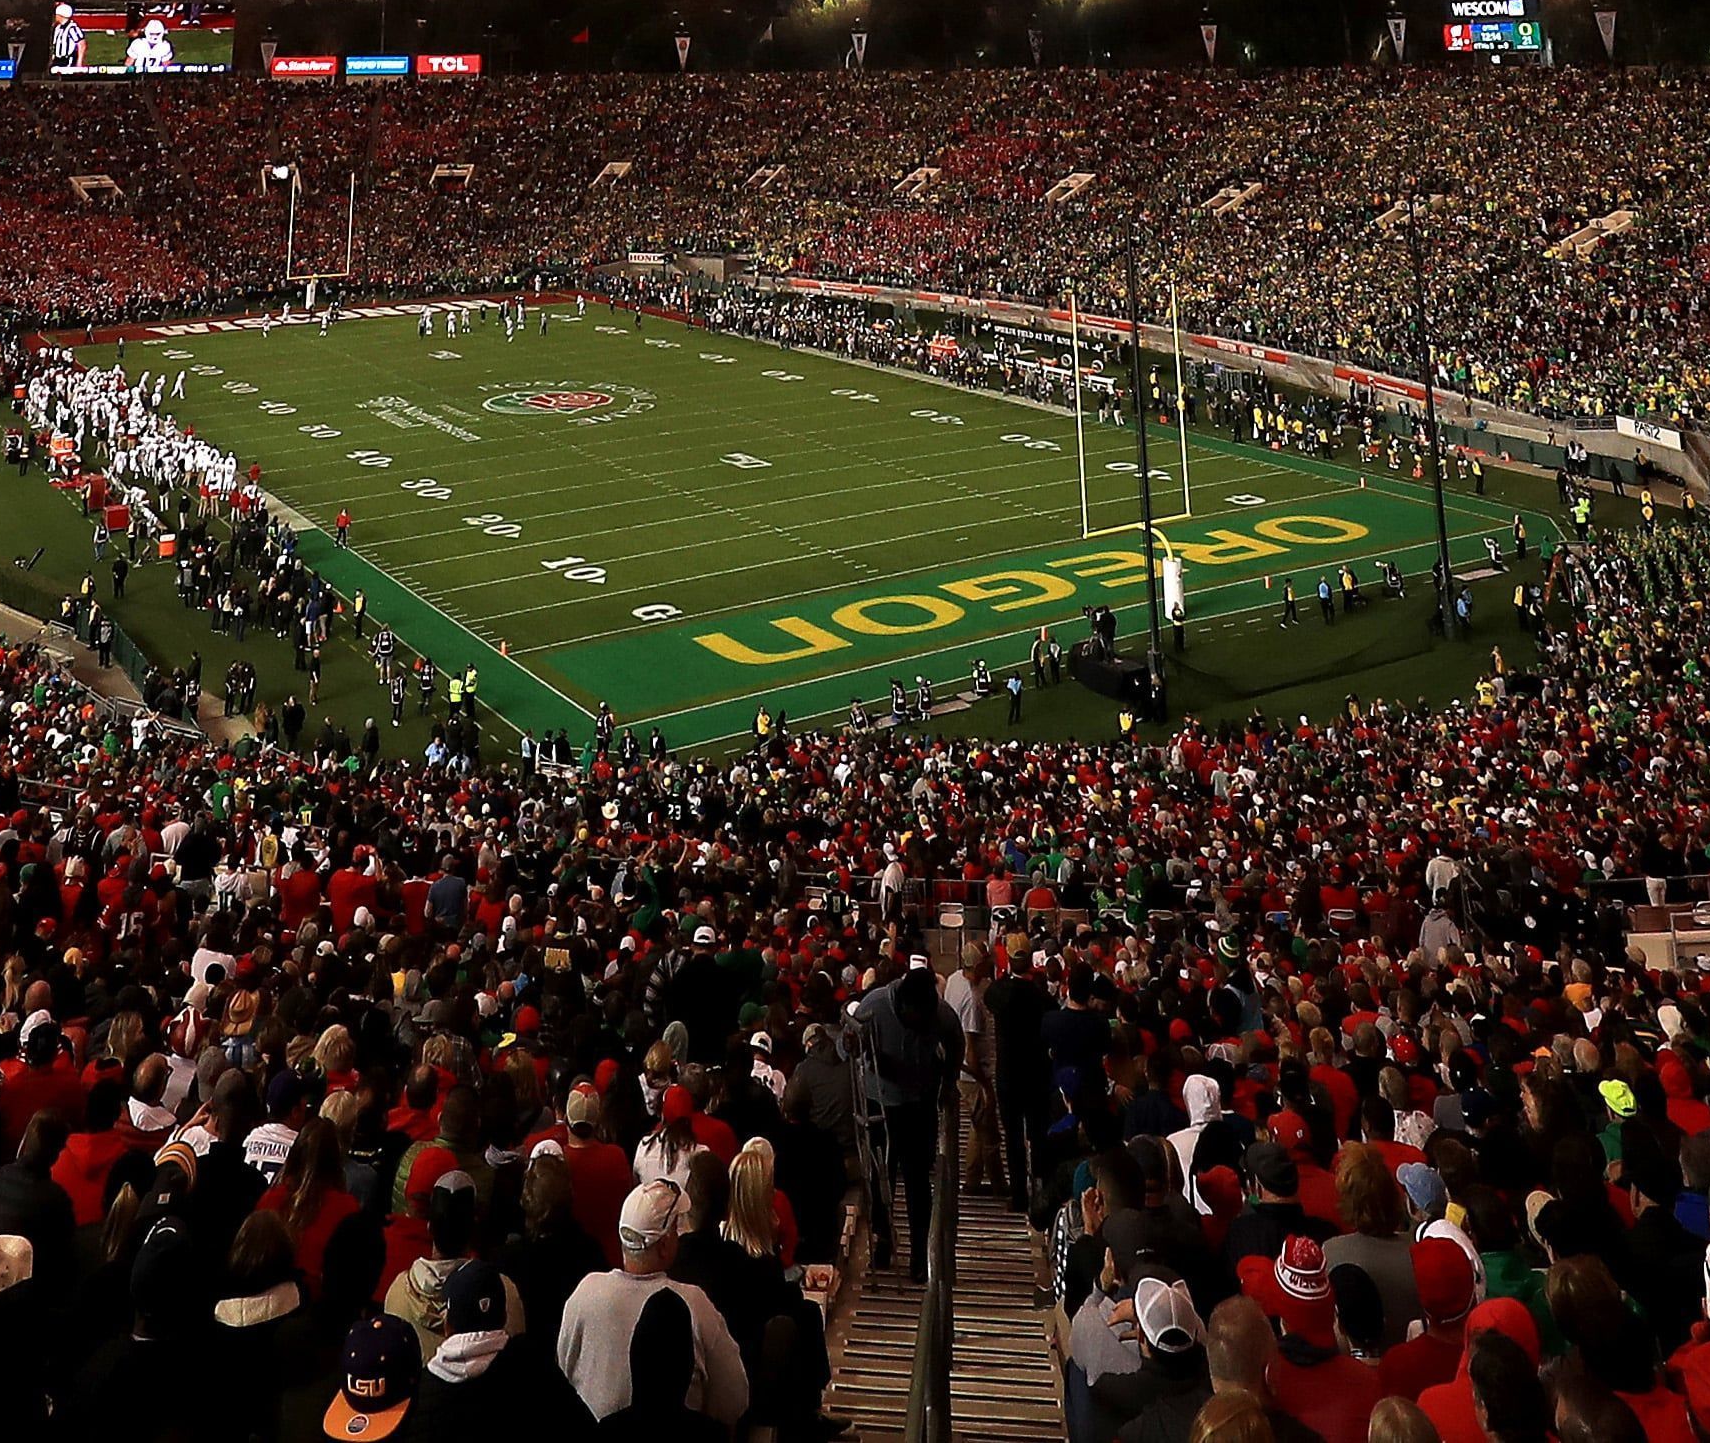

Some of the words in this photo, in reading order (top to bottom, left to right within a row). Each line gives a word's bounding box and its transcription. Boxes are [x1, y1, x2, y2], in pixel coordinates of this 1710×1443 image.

[1451, 0, 1509, 16] WESCOM
[429, 56, 469, 72] TCL
[145, 299, 504, 337] WISCONSIN
[258, 400, 297, 415] 40
[298, 423, 342, 438] 50
[346, 450, 393, 469] 40
[400, 478, 453, 501] 30
[461, 514, 522, 539] 20
[540, 556, 608, 585] 10
[694, 515, 1369, 665] OREGON
[631, 603, 682, 625] G
[116, 911, 144, 942] 16
[346, 1372, 384, 1398] LSU
